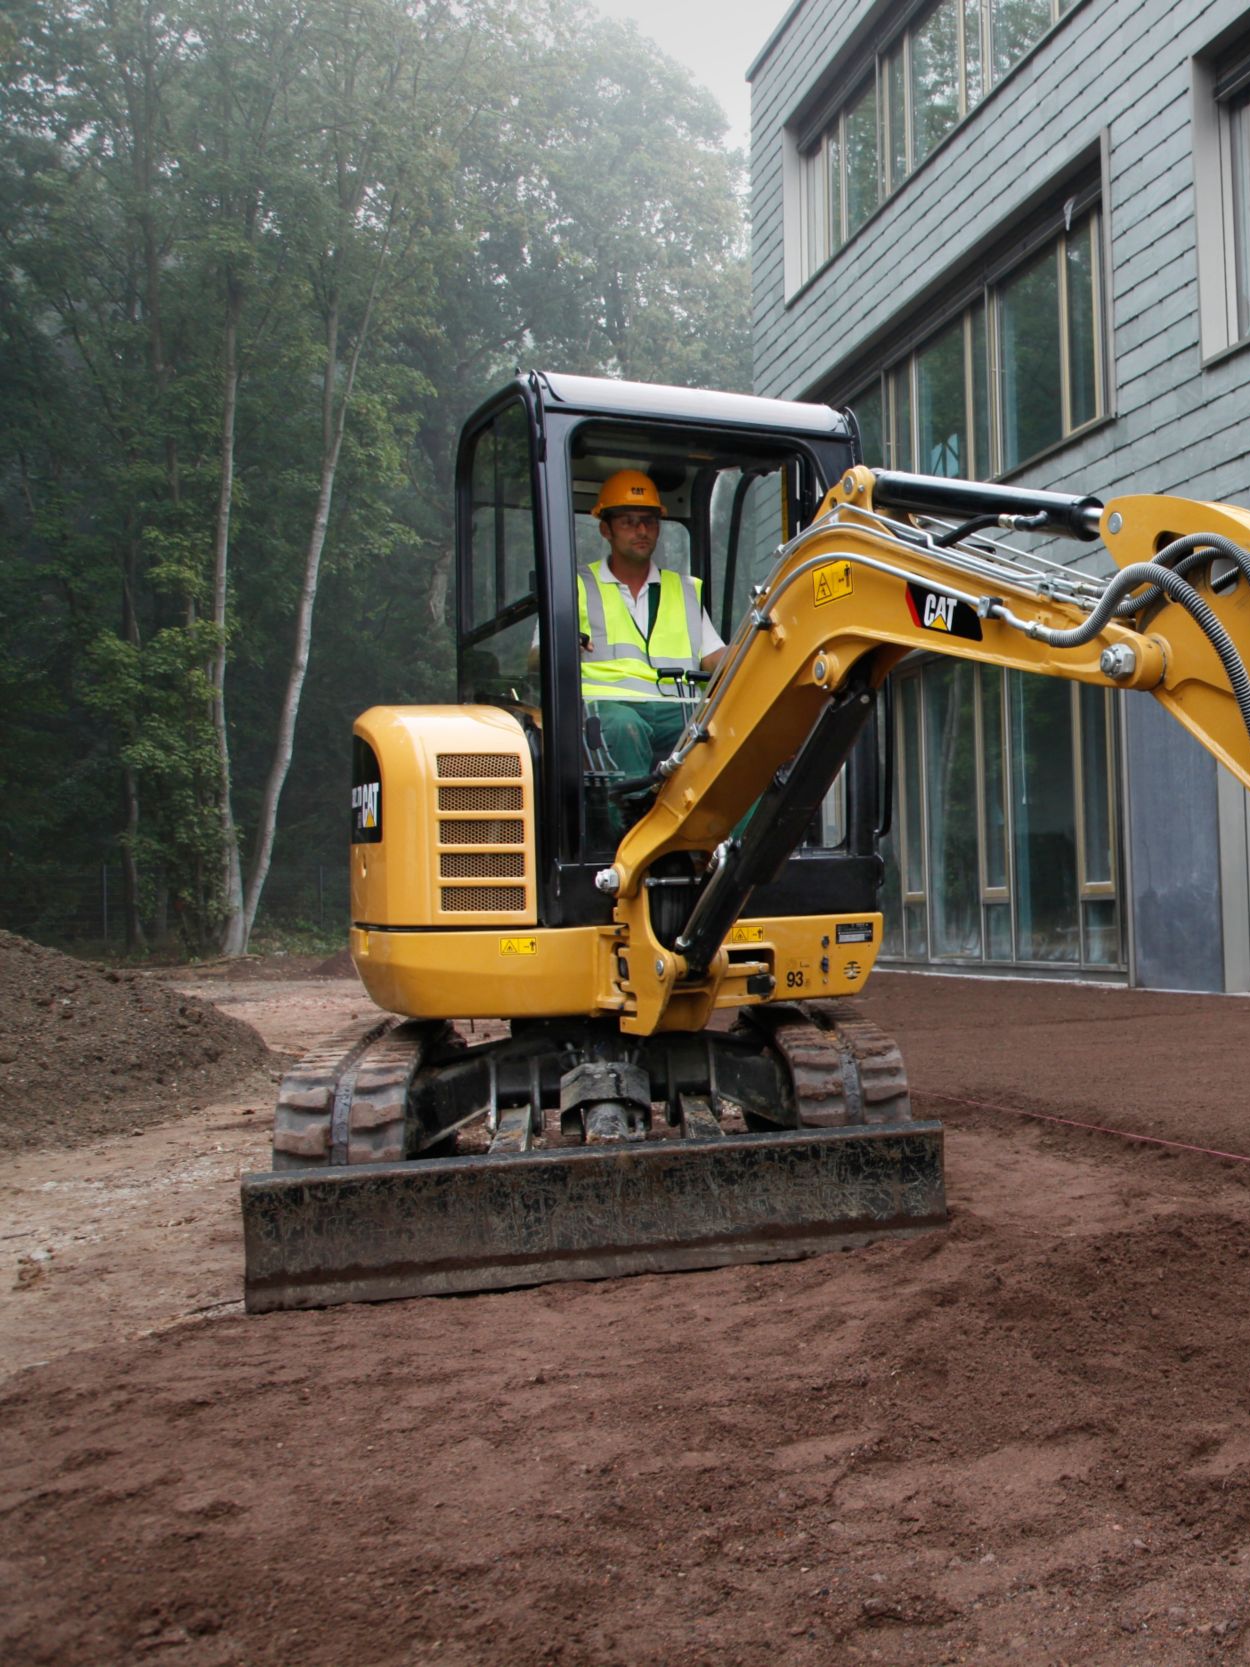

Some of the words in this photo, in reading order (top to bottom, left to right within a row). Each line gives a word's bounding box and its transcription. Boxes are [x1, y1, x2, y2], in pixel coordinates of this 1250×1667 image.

[631, 487, 645, 495] CAT
[923, 593, 958, 632] CAT
[363, 783, 379, 828] CAT
[786, 971, 804, 988] 93
